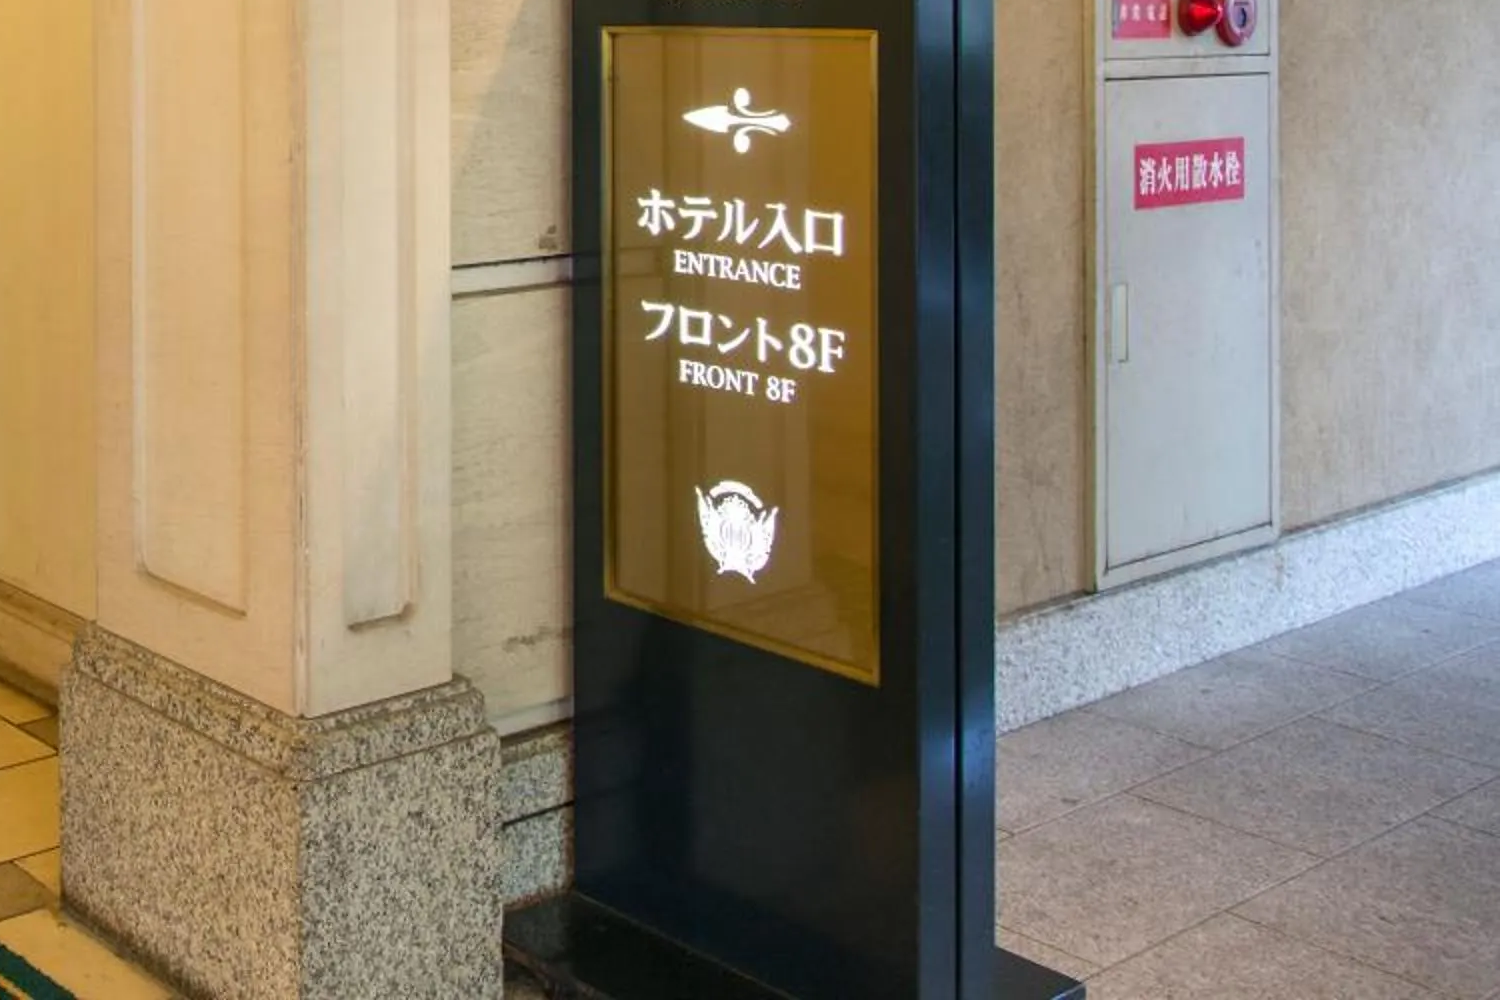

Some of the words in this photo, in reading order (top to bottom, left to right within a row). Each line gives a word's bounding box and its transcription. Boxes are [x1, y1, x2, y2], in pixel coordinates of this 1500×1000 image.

[637, 188, 844, 256] ホテル入口
[673, 249, 801, 289] ENTRANCE
[641, 299, 845, 373] フロント8F
[679, 359, 759, 396] FRONT
[766, 376, 796, 403] 8F
